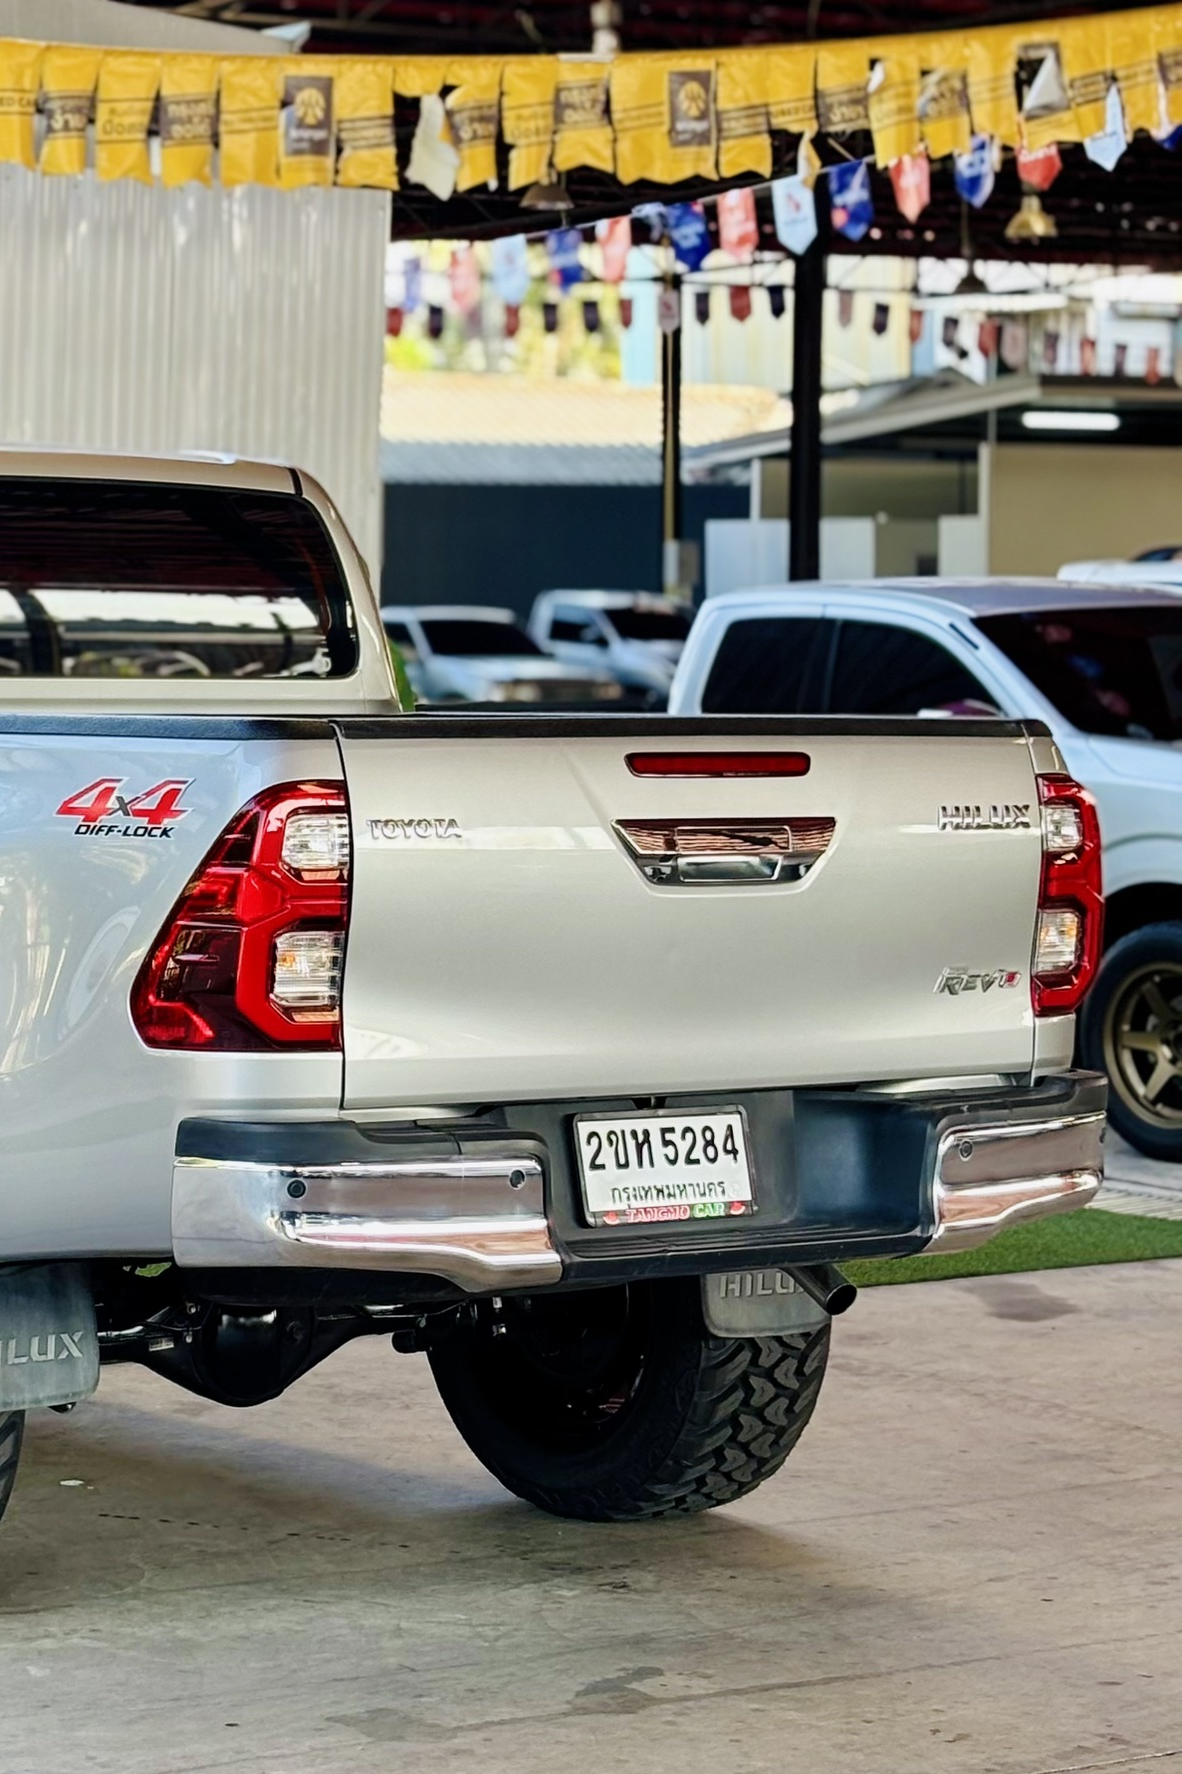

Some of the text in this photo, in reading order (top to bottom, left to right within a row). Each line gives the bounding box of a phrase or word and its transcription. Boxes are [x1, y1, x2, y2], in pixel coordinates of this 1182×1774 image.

[74, 824, 175, 838] DIFF-LOCK
[366, 818, 462, 840] TOYOTA
[938, 804, 1031, 831] HILUX
[659, 1123, 739, 1167] 5284
[611, 1180, 726, 1208] กรุงเทพมหานคร
[692, 1202, 725, 1218] CAR
[719, 1271, 805, 1299] HILU
